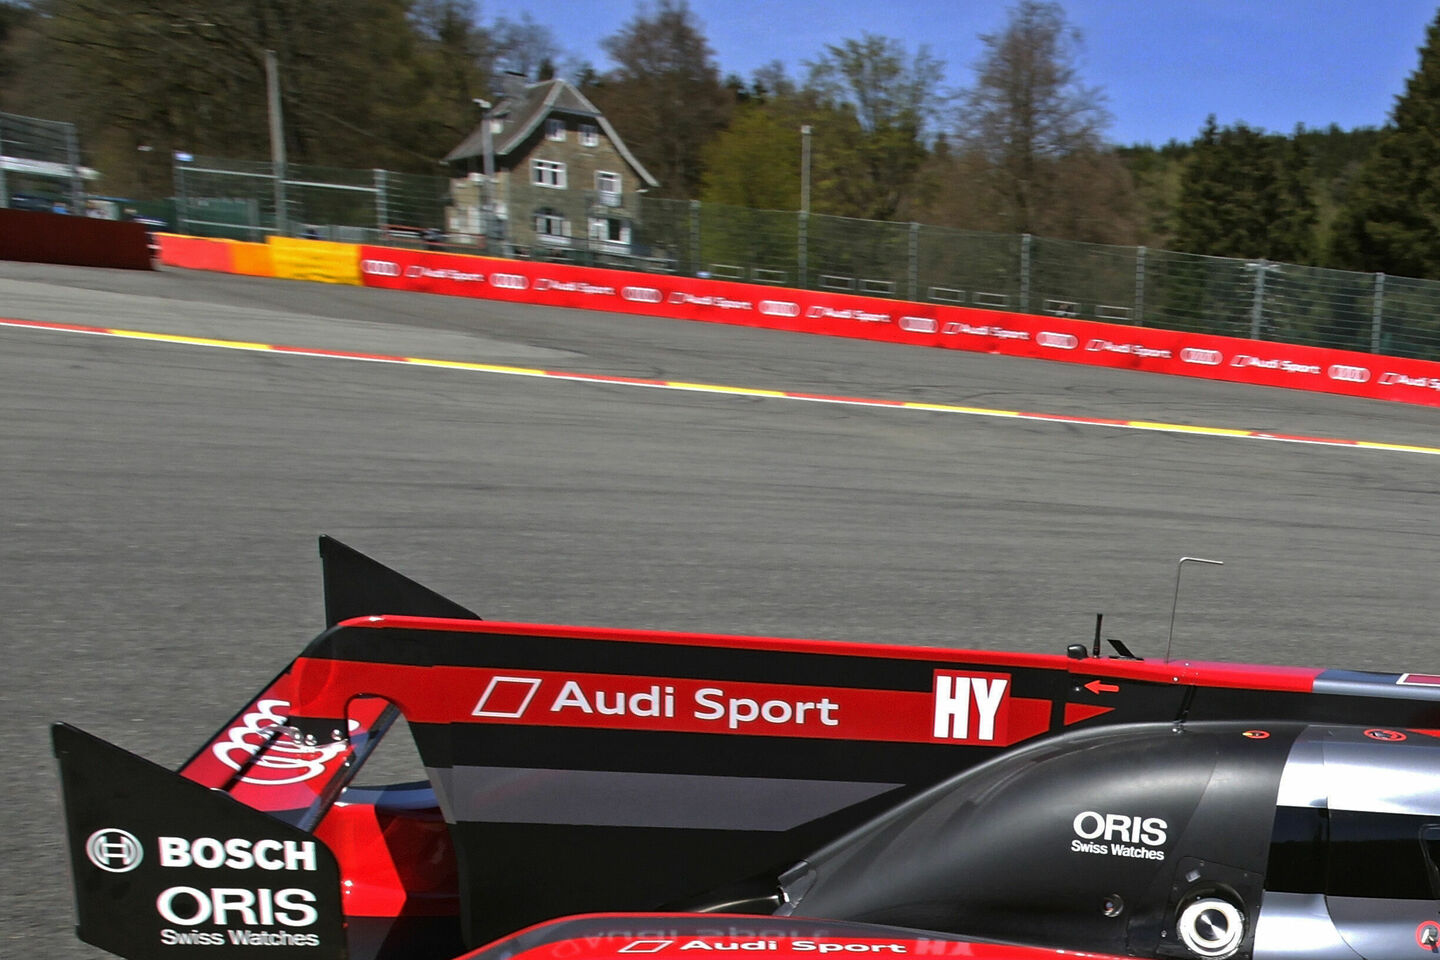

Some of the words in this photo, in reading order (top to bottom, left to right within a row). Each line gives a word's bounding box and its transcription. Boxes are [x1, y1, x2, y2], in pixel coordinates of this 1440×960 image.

[550, 681, 675, 719] Audi
[693, 687, 840, 729] Sport
[933, 675, 1007, 740] HY
[1073, 811, 1168, 847] ORIS
[157, 836, 318, 871] BOSCH
[1071, 839, 1108, 856] Swiss
[1111, 843, 1165, 861] Watches
[156, 886, 319, 928] ORIS
[161, 929, 225, 946] Swiss
[227, 930, 320, 947] Watches
[679, 940, 777, 951] Audi
[791, 940, 907, 954] Sport
